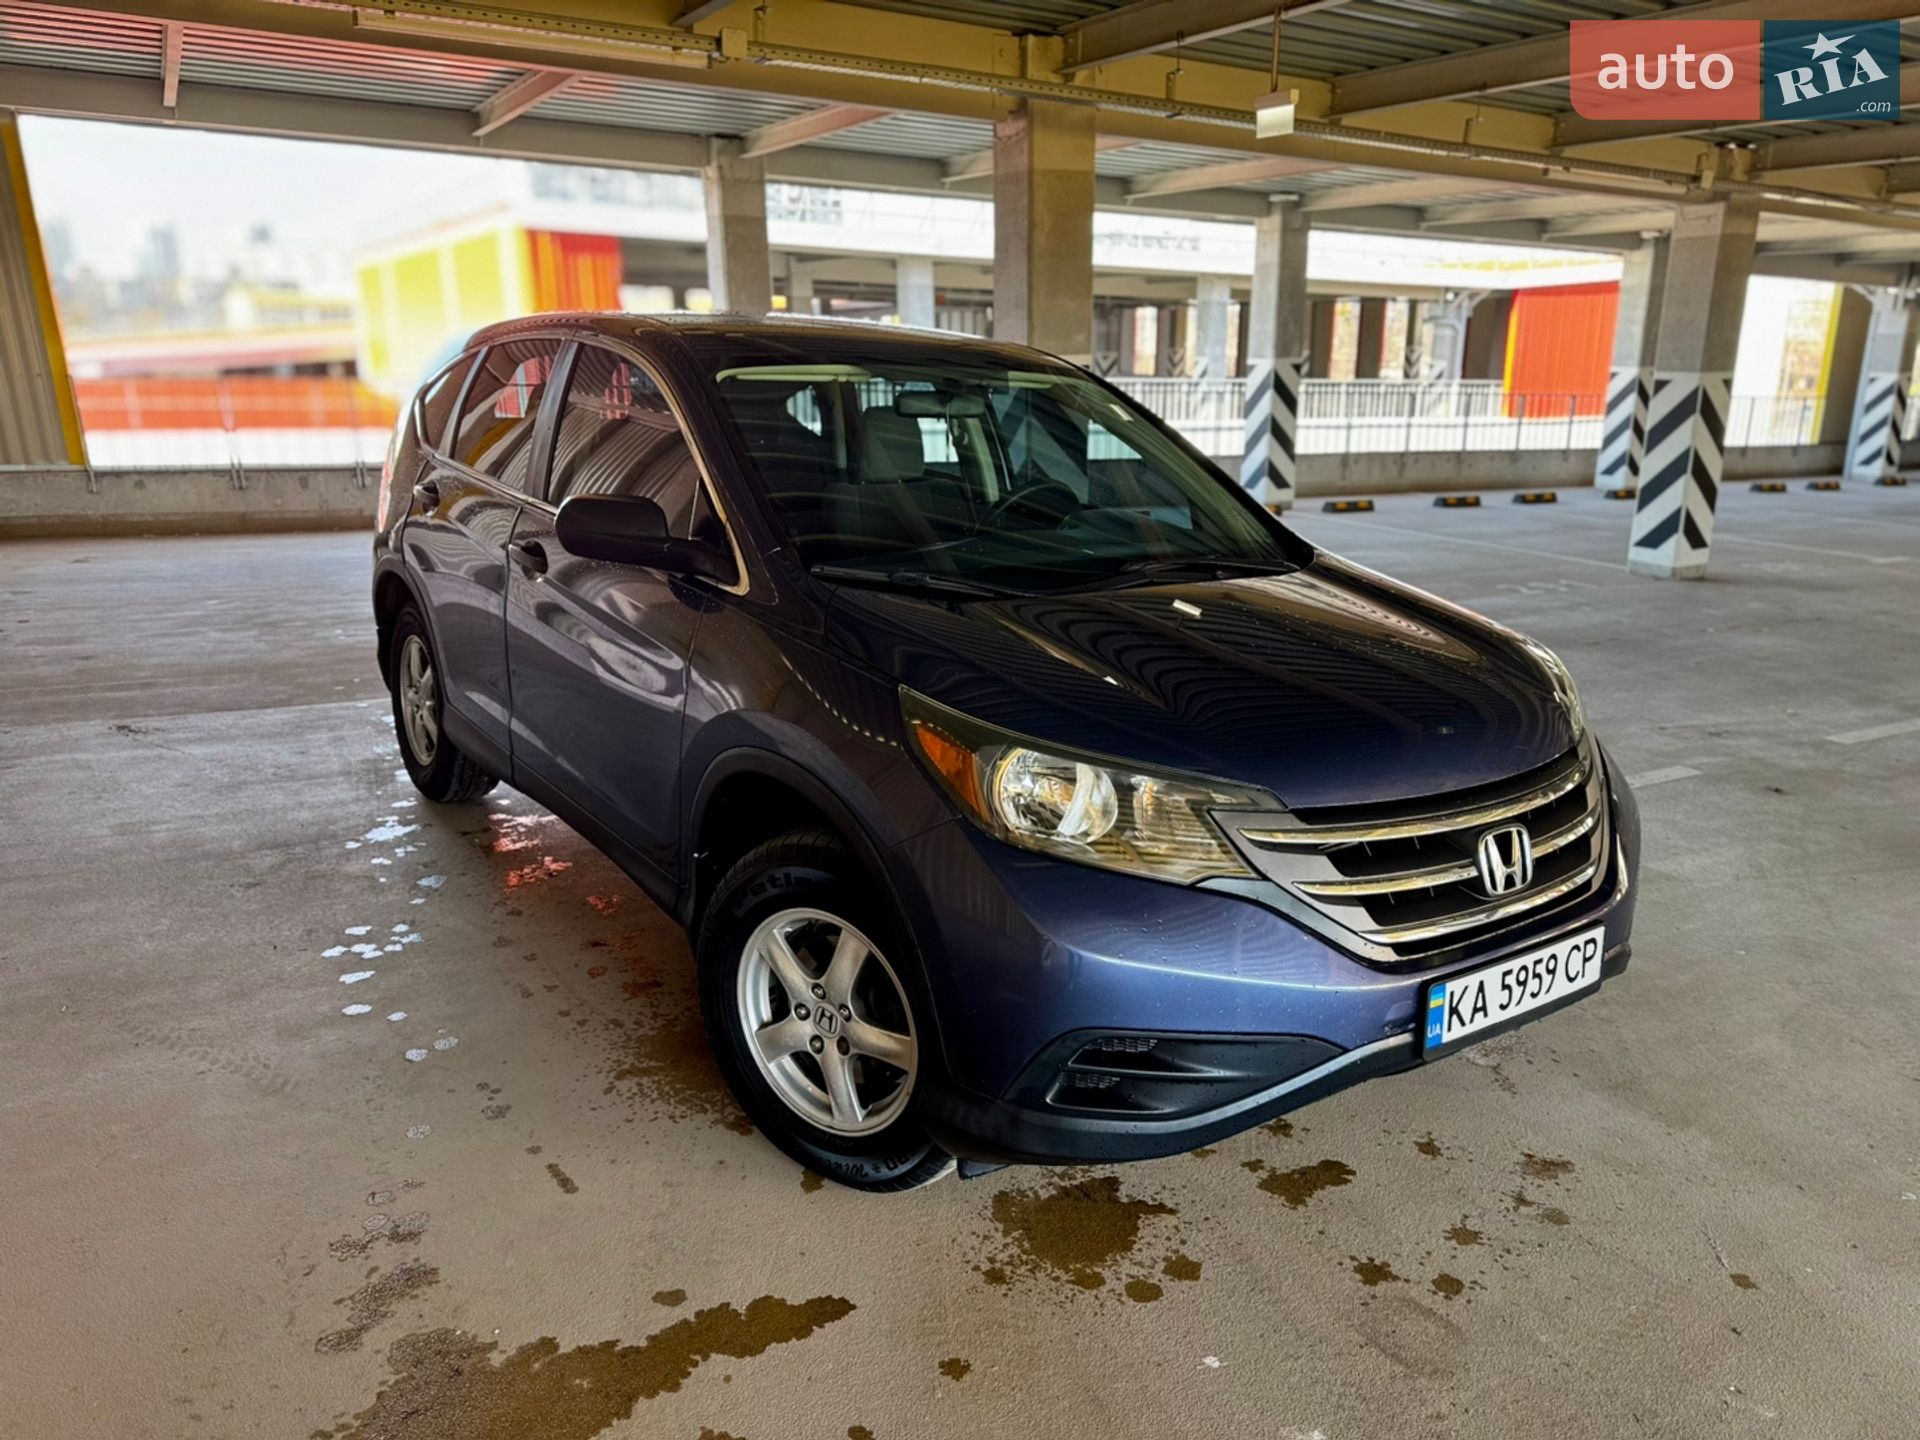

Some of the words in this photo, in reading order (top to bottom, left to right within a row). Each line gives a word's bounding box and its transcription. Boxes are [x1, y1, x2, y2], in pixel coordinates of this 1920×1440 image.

[1447, 980, 1488, 1032] KA
[1499, 953, 1558, 1011] 5959
[1565, 937, 1598, 983] CP
[1427, 1025, 1441, 1038] UA
